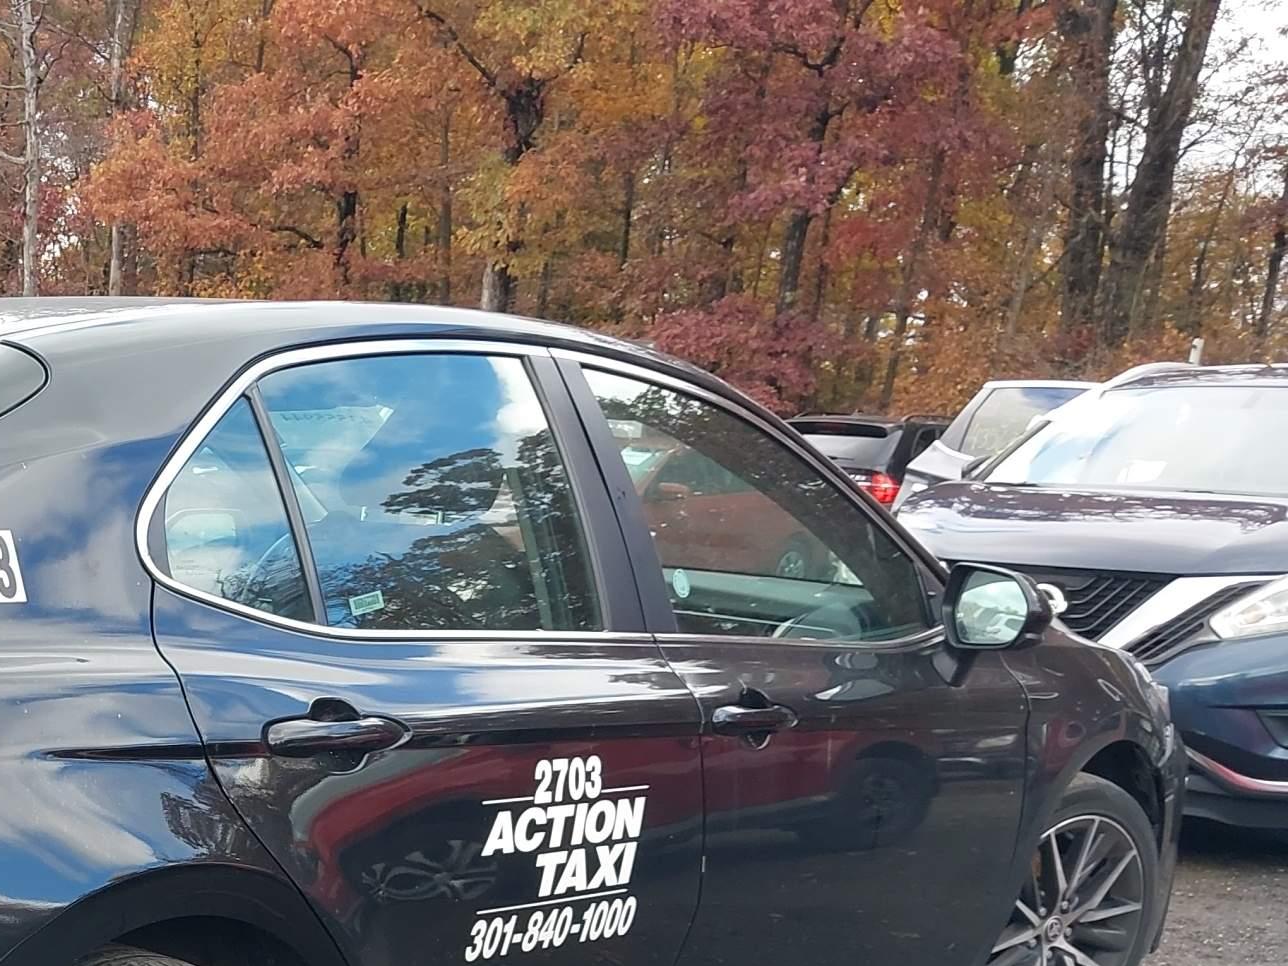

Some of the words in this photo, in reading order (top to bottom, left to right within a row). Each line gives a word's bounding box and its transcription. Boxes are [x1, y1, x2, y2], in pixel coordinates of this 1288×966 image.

[533, 755, 602, 804] 2703
[481, 797, 646, 856] ACTION
[535, 841, 638, 898] TAXI
[464, 896, 637, 962] 301-840-1000
